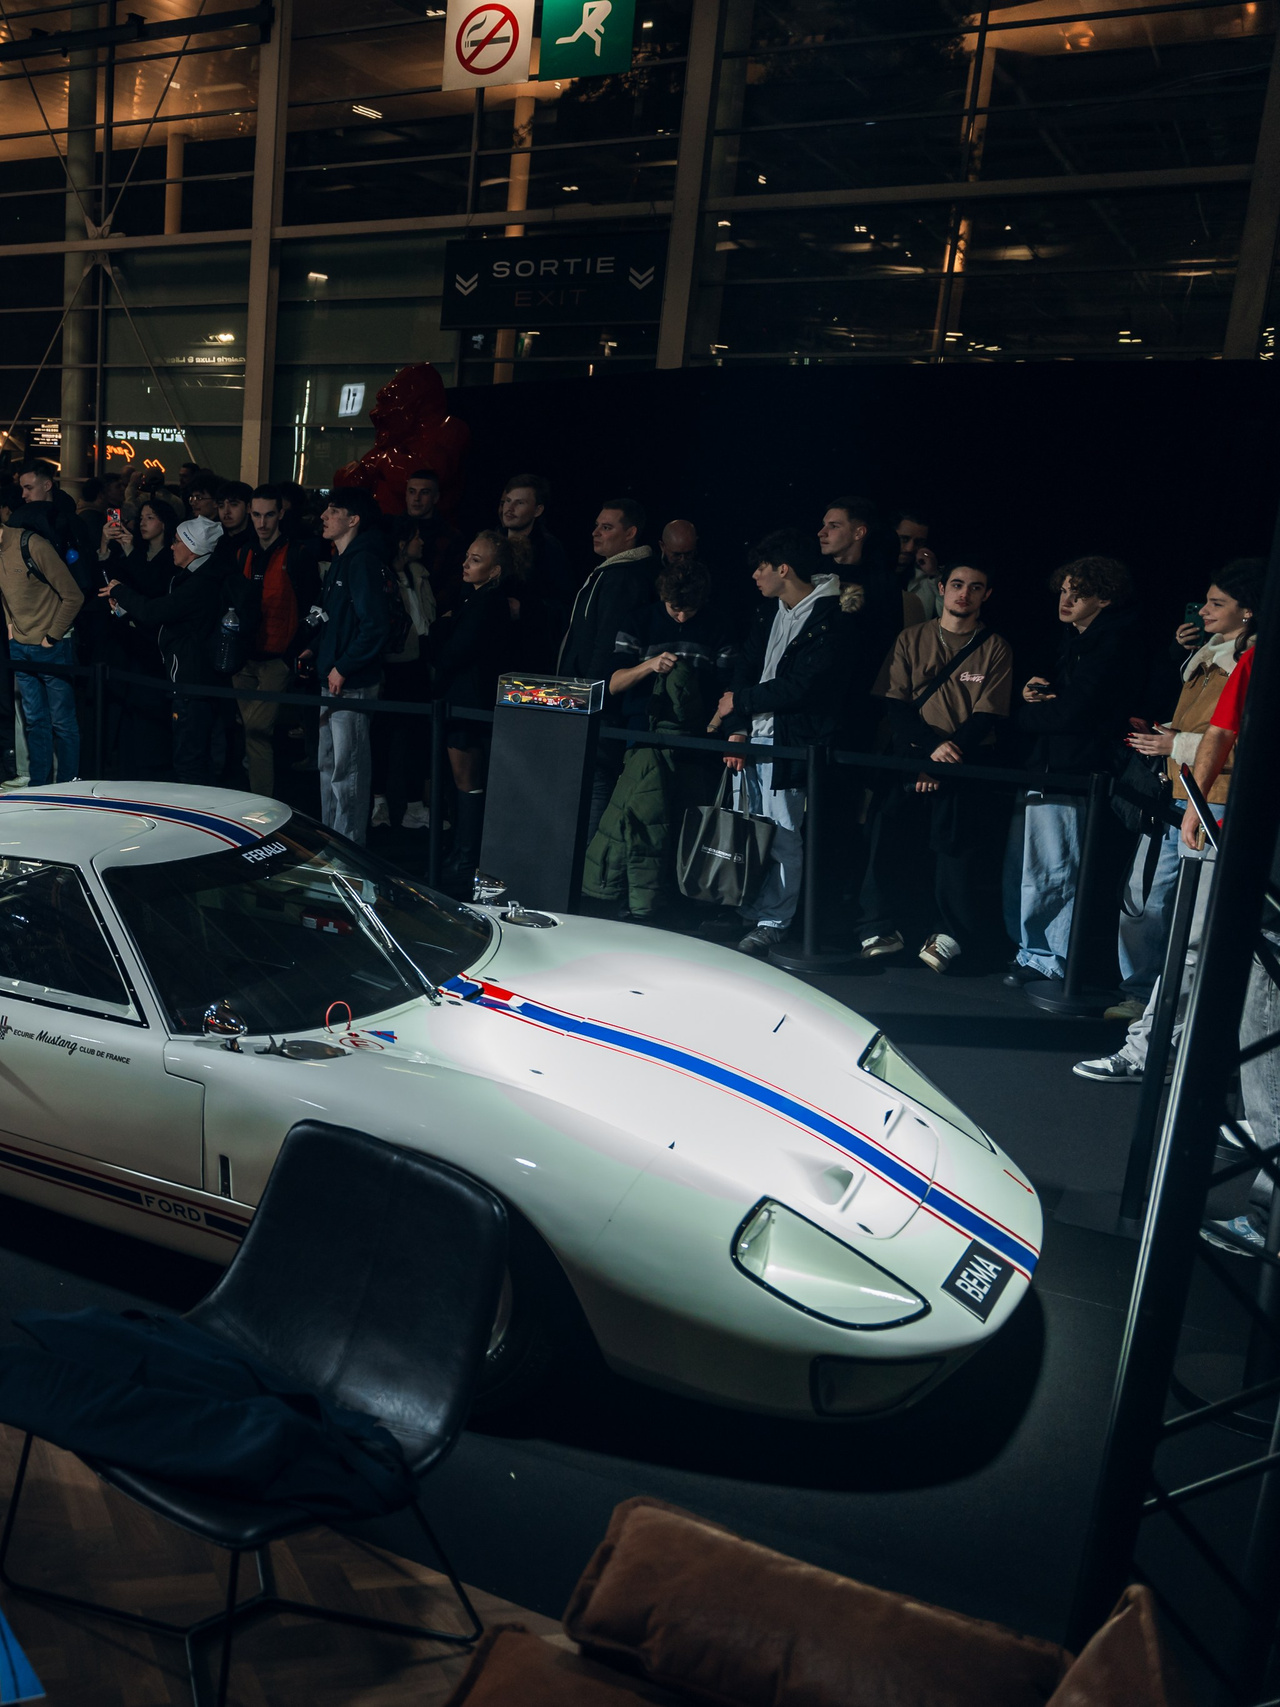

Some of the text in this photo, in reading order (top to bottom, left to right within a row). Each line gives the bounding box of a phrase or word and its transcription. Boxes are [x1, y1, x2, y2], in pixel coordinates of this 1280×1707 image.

[491, 256, 616, 279] SORTIE
[513, 289, 587, 308] EXIT
[13, 1029, 131, 1065] ECURIE Mustang CLUB DE FRANCE
[144, 1194, 201, 1222] FORD
[954, 1254, 1003, 1304] BEMA
